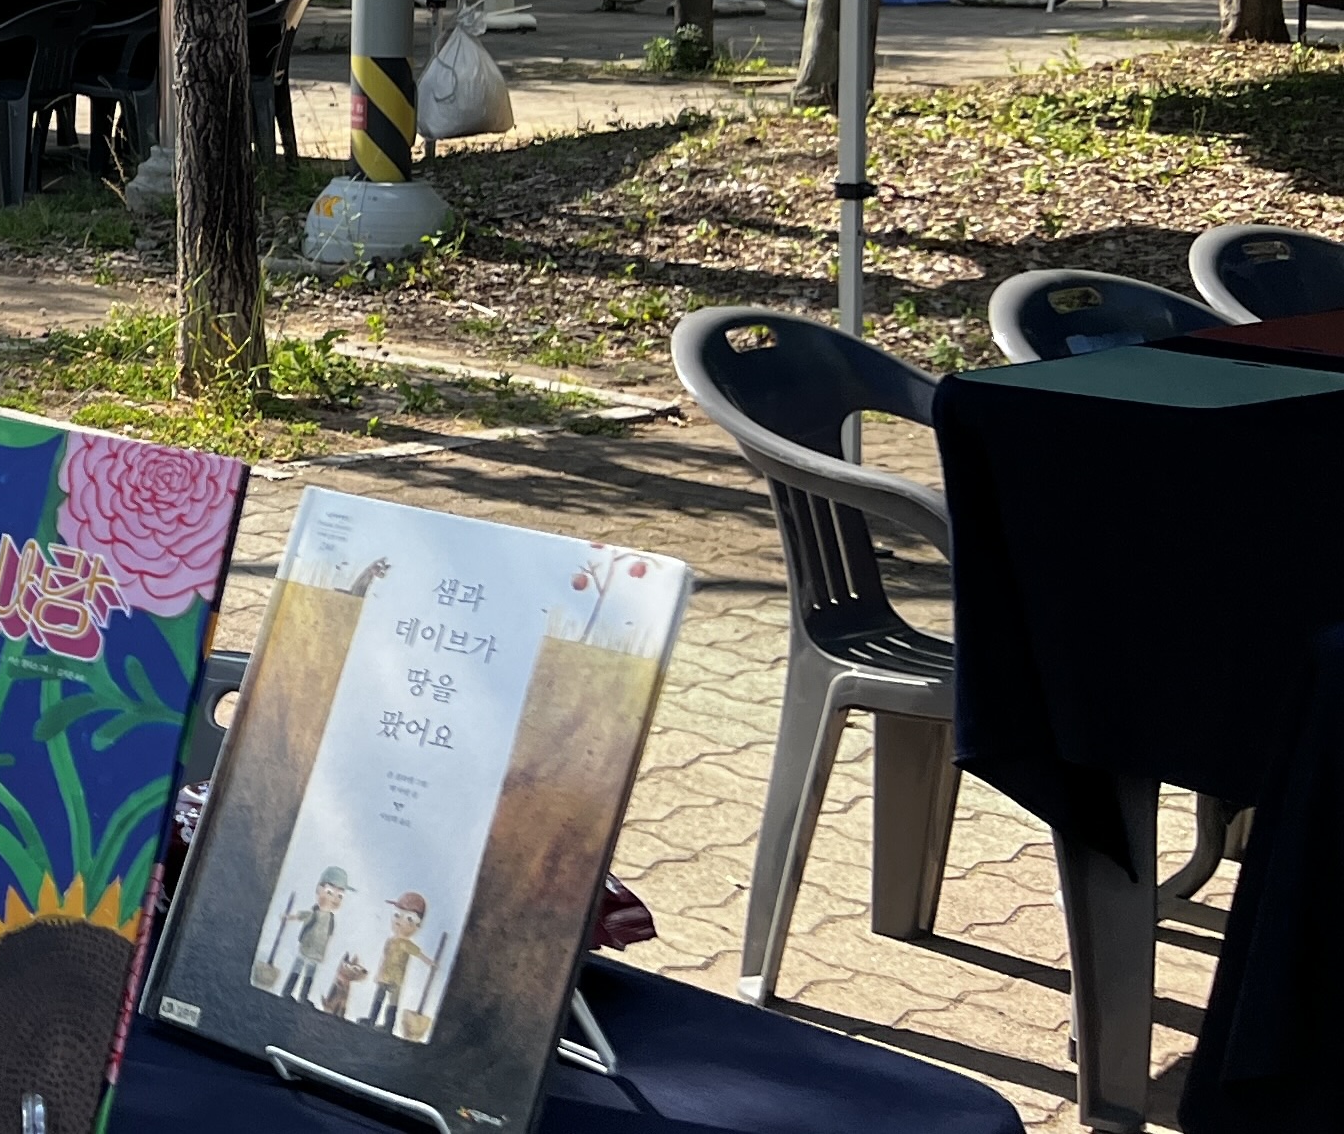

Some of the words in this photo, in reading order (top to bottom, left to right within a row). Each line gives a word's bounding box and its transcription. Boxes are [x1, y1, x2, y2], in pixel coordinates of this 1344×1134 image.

[433, 578, 487, 613] 샘과
[396, 617, 498, 664] 데이브가
[407, 669, 457, 703] 땅을
[376, 711, 454, 750] 팠어요
